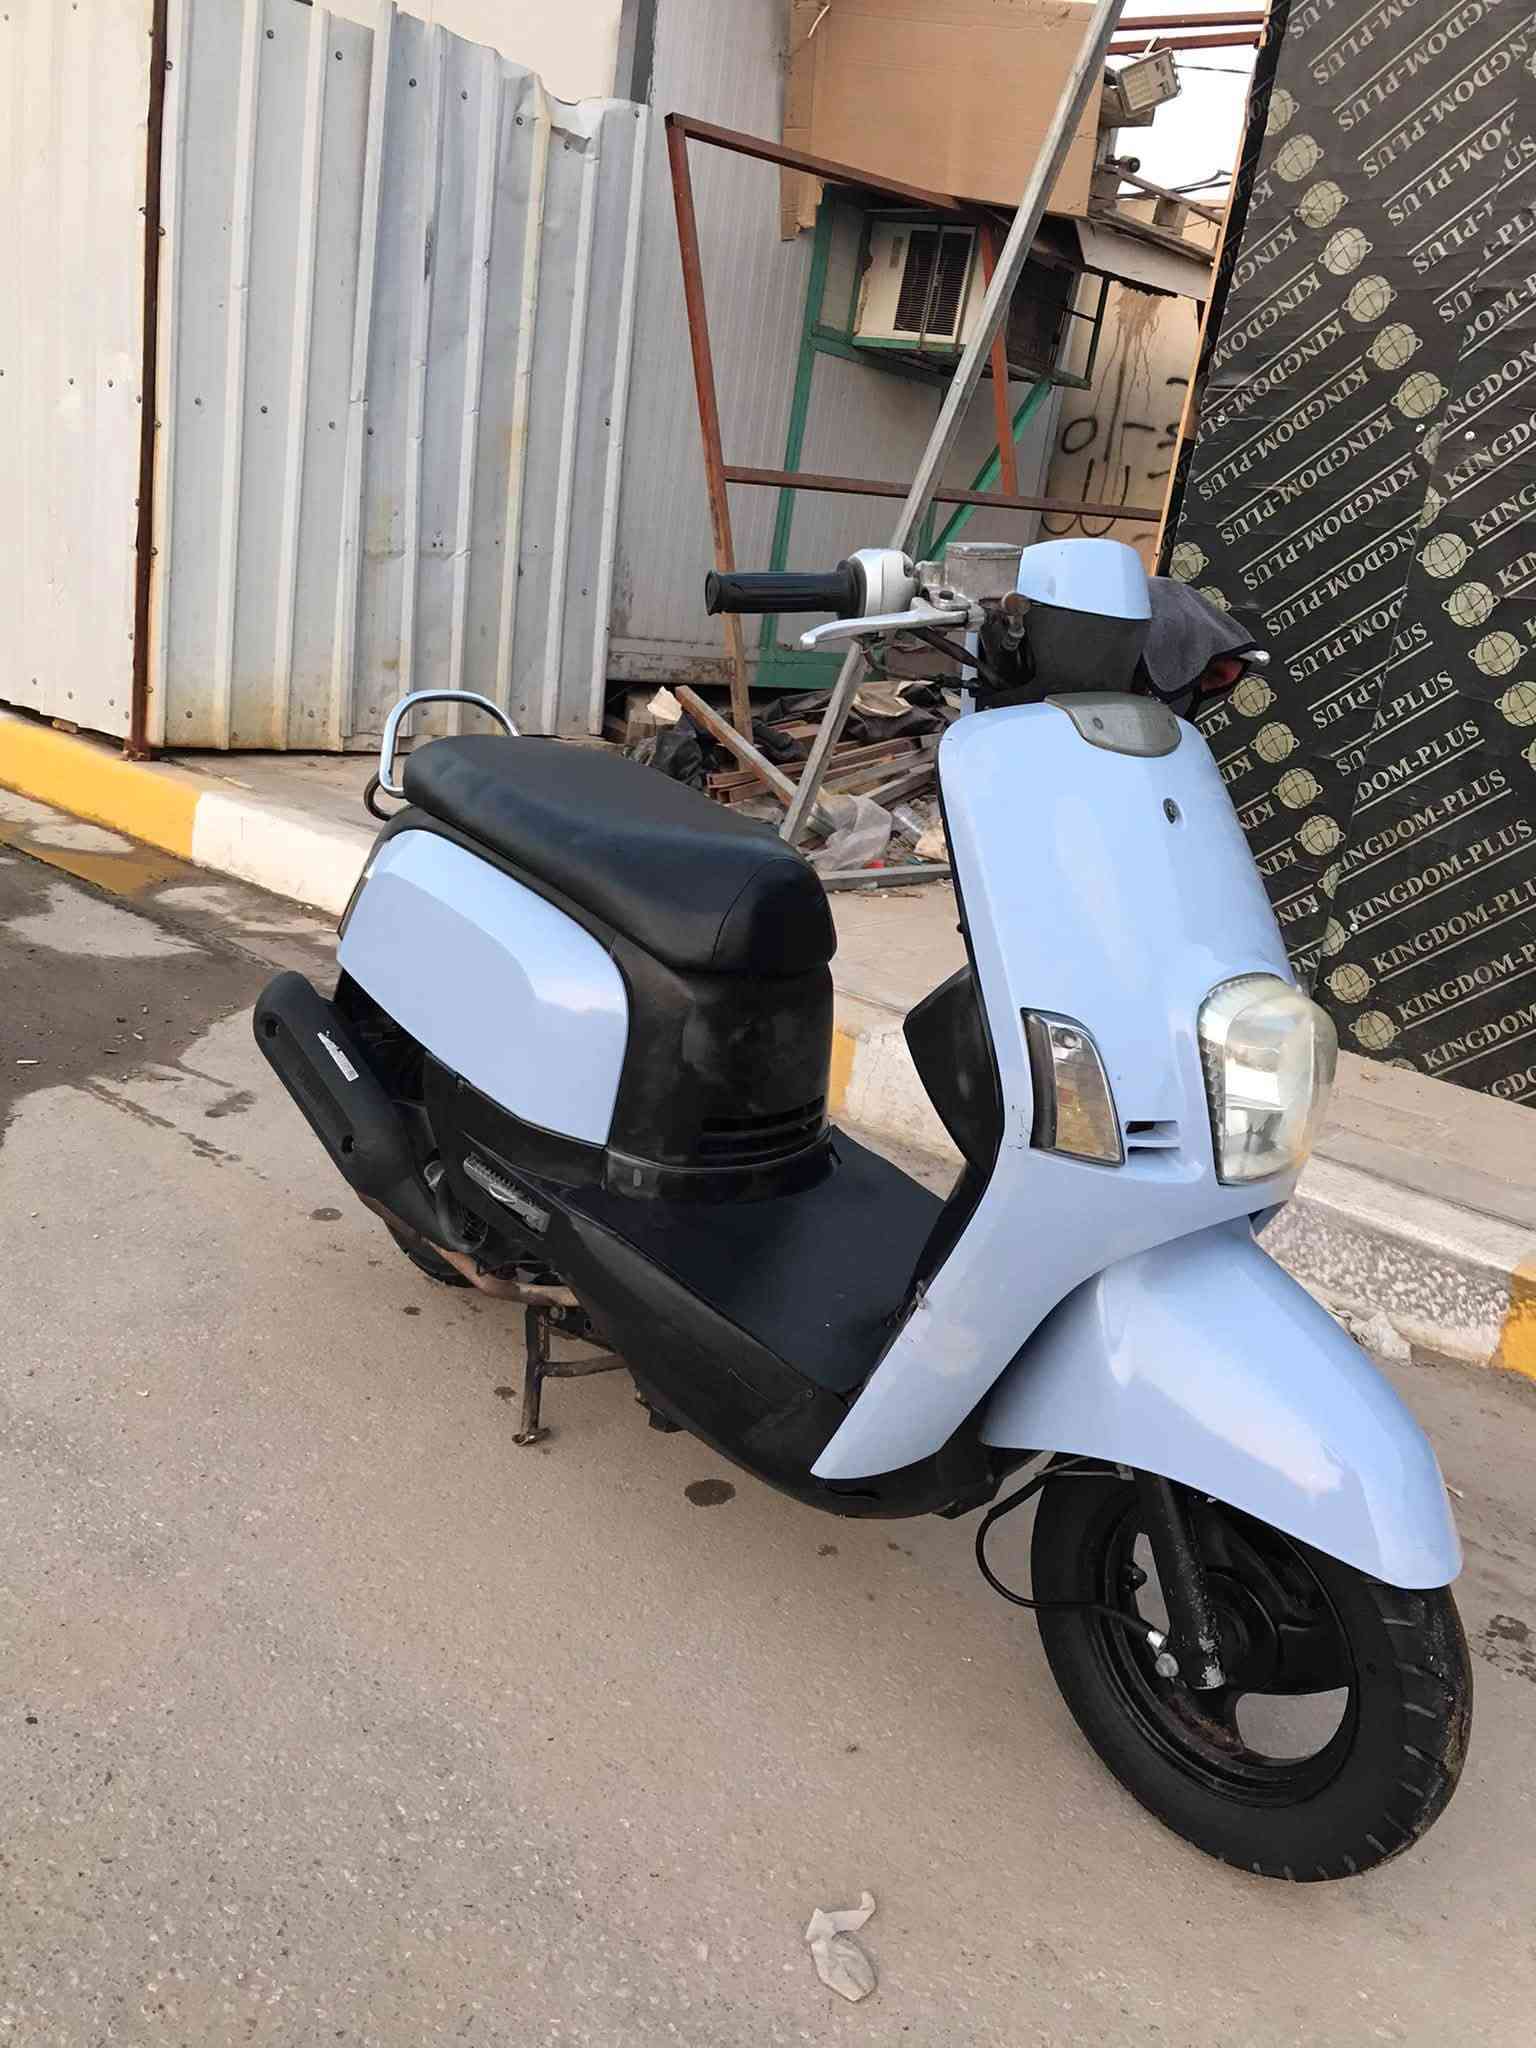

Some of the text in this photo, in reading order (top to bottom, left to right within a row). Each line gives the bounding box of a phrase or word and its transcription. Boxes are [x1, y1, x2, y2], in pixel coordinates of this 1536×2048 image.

[1198, 366, 1370, 501] KINGDOM-PLUS
[1220, 414, 1396, 546] KINGDOM-PLUS
[1243, 460, 1420, 591] KINGDOM-PLUS
[1347, 819, 1532, 925] KINGDOM-PLUS
